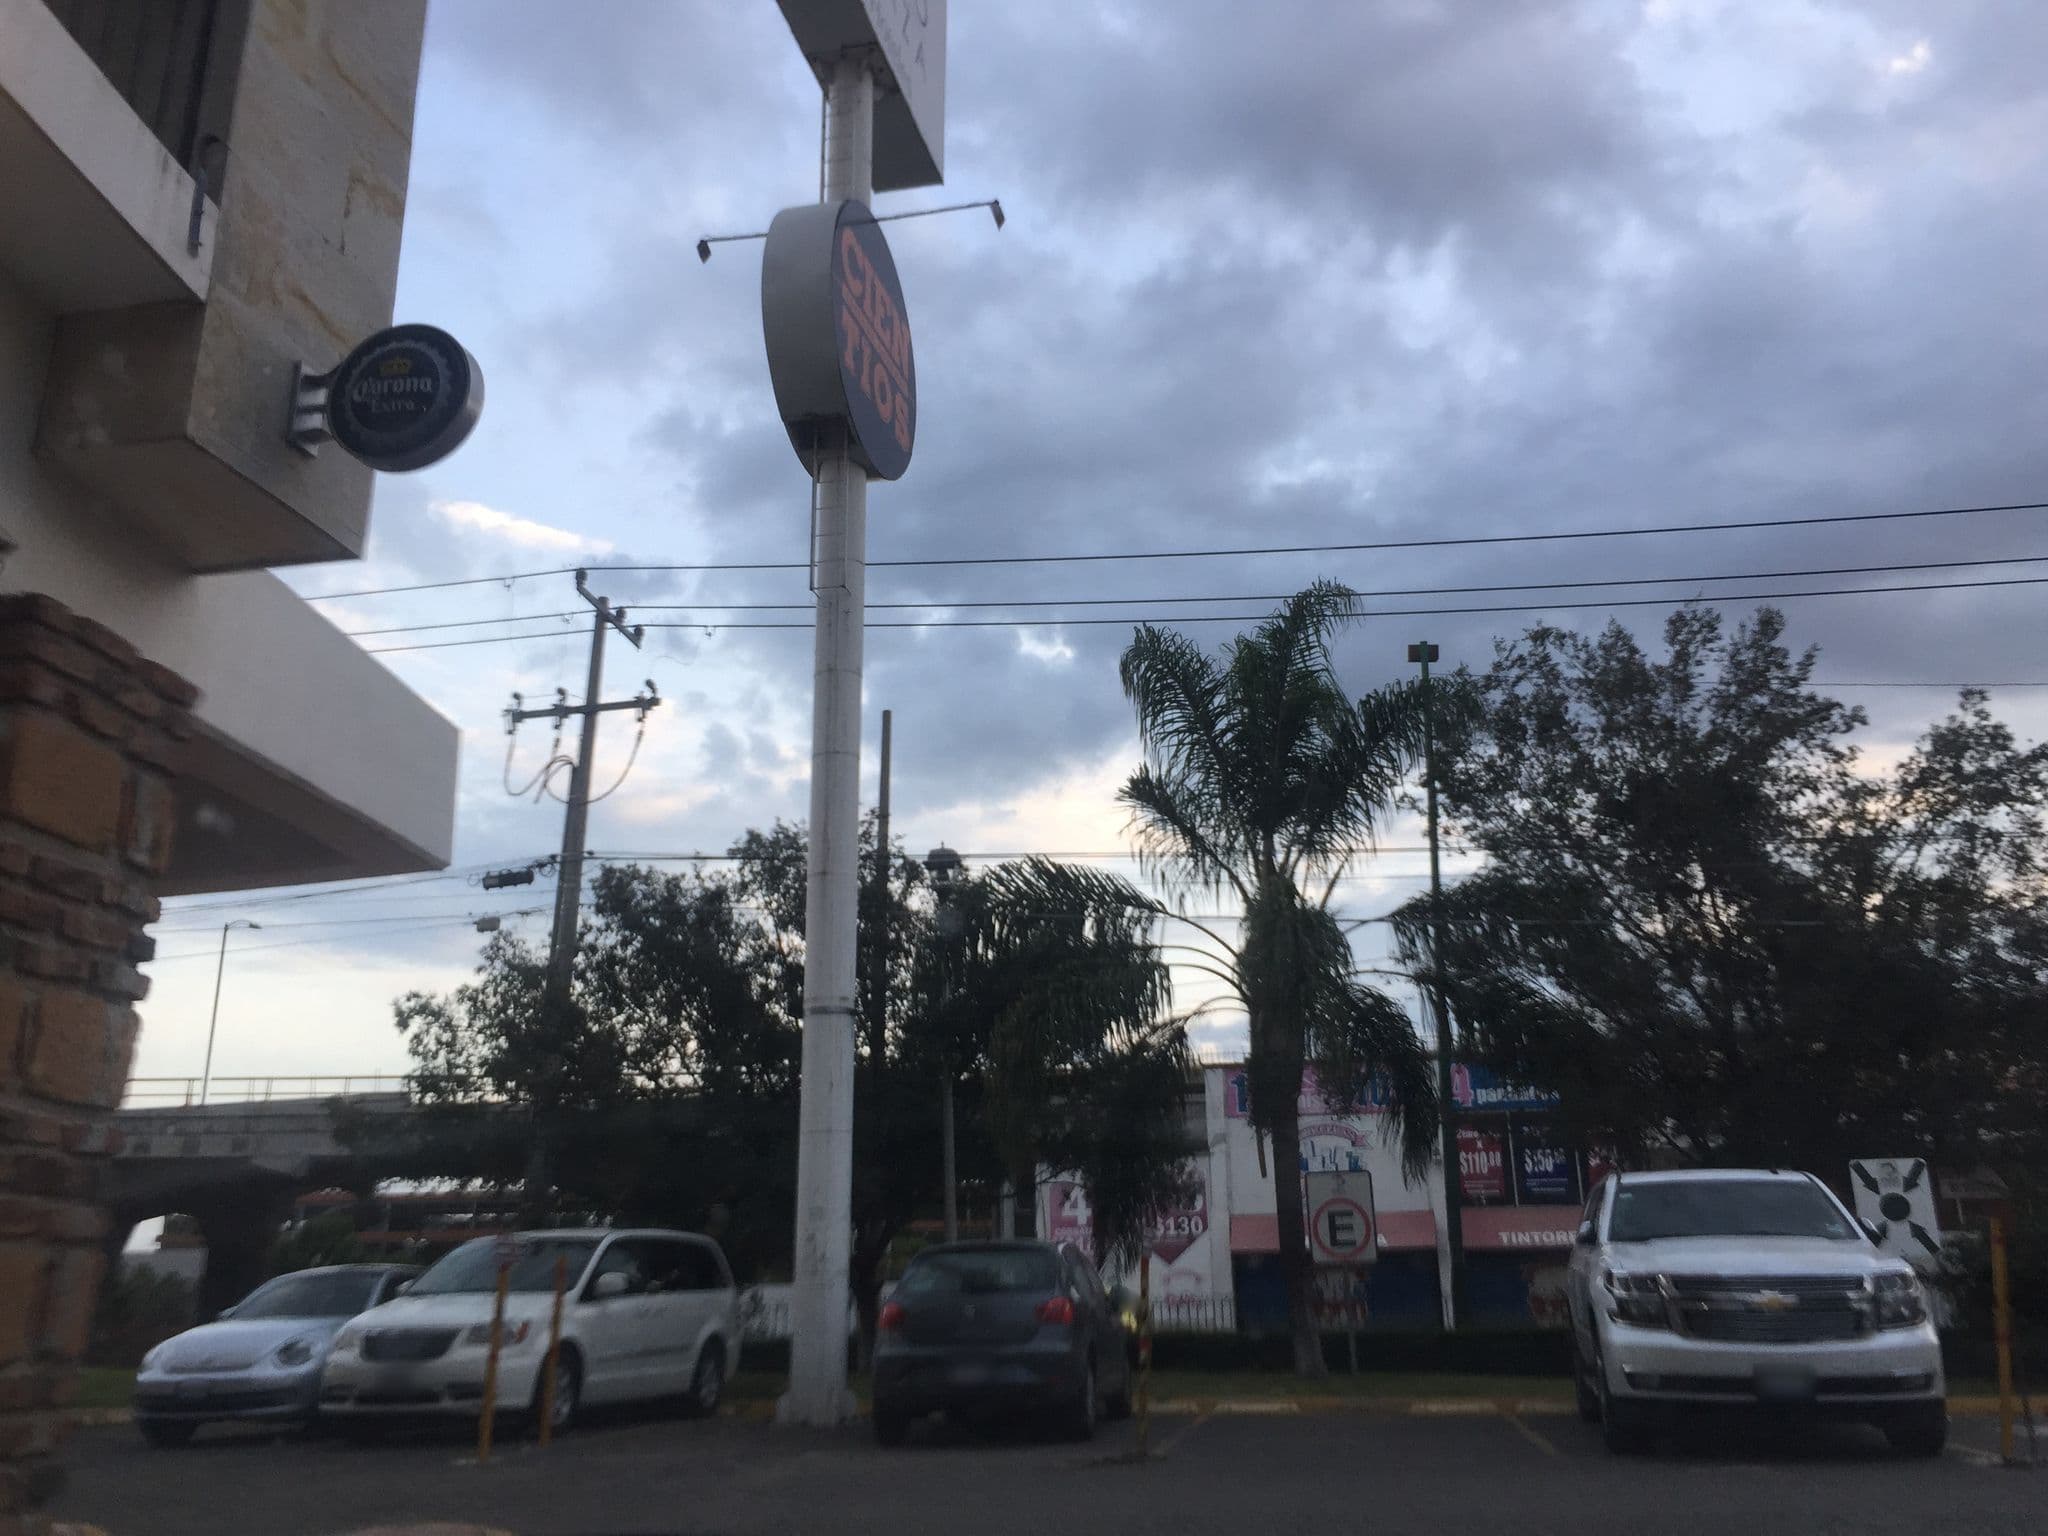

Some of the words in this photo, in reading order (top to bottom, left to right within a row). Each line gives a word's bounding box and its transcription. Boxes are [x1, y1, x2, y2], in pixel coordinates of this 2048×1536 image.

[352, 376, 432, 403] Corona
[1061, 1185, 1092, 1225] 4
[1328, 1209, 1356, 1248] E
